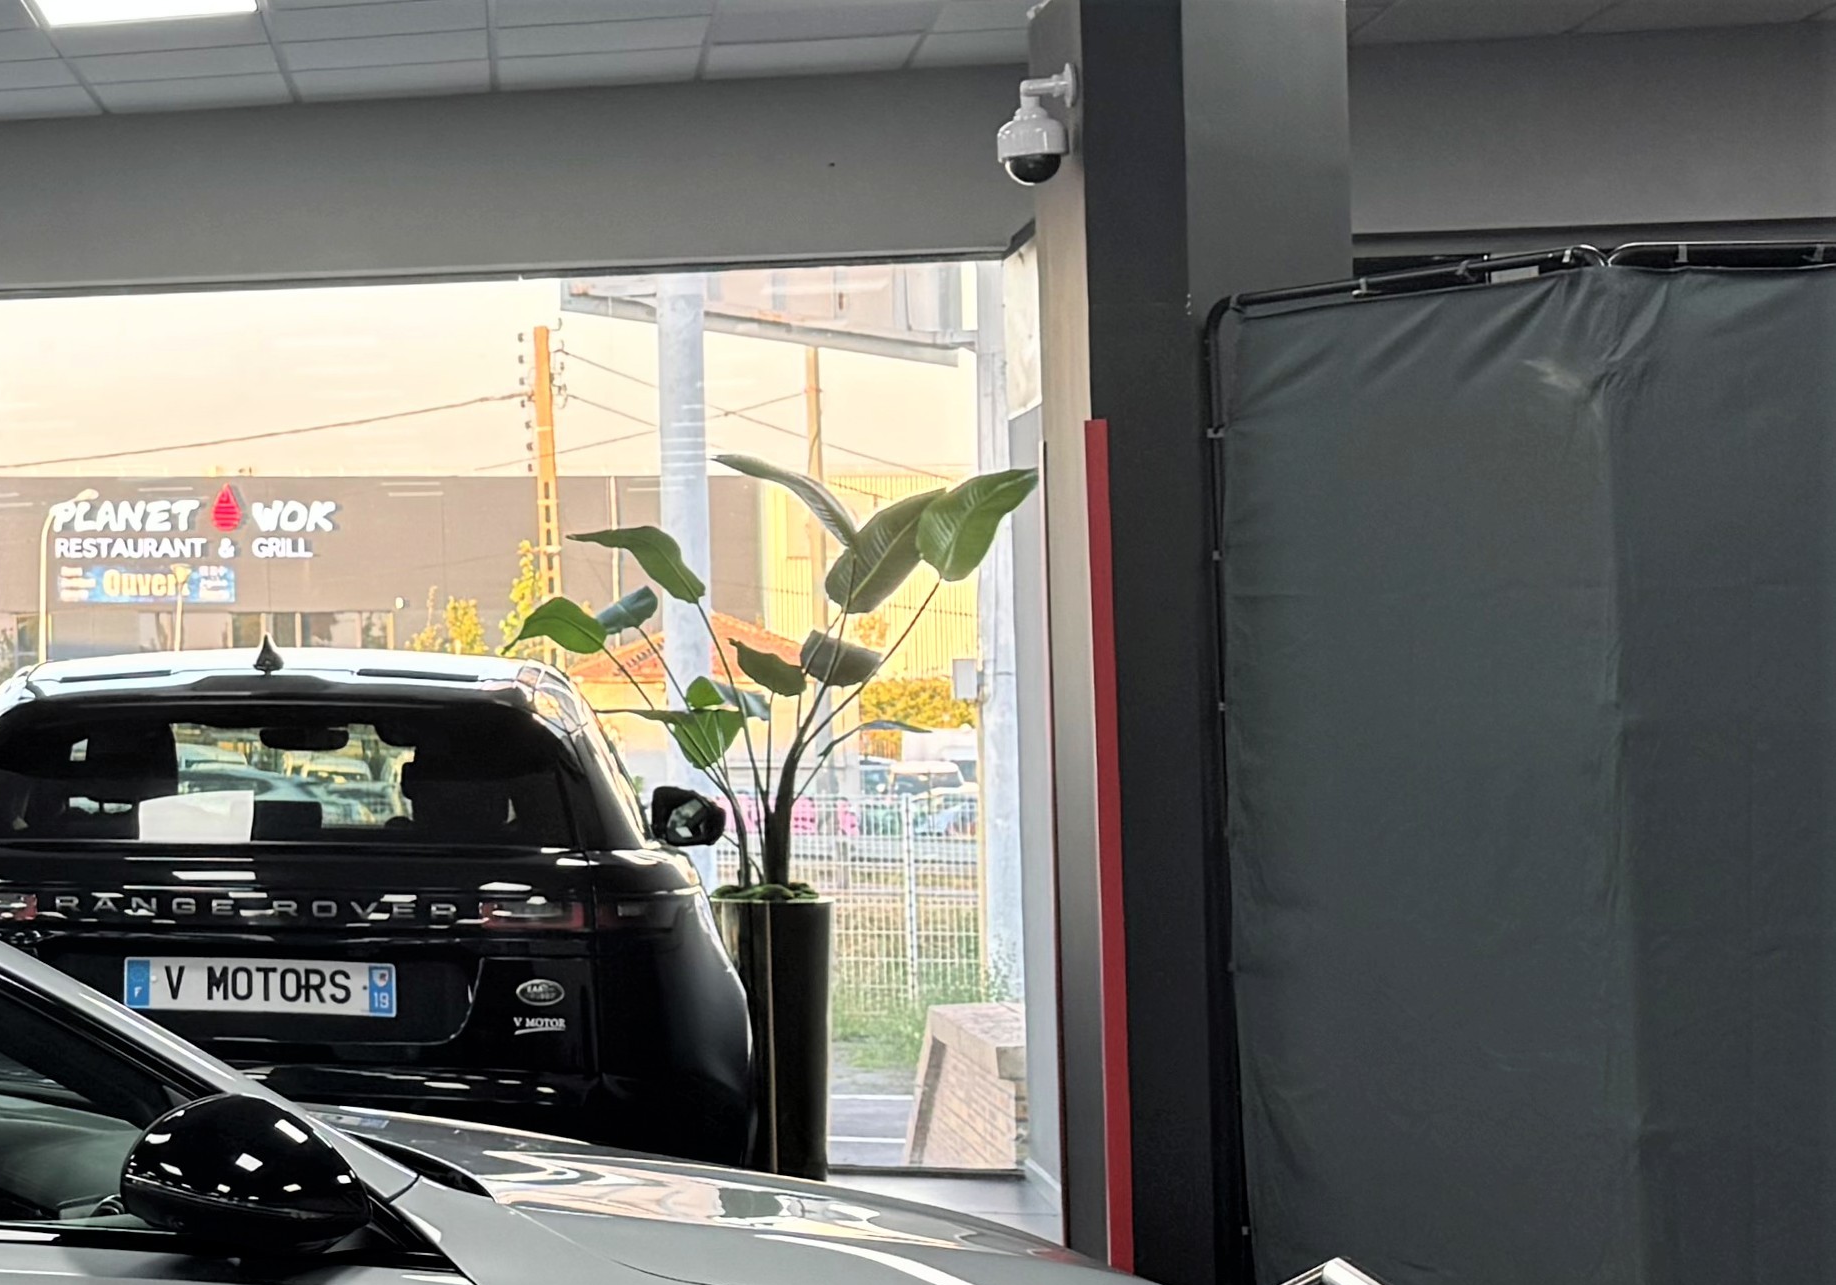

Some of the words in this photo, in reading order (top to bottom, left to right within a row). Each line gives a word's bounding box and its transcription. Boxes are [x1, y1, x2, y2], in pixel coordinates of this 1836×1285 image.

[51, 499, 200, 532] PLANET
[251, 499, 336, 532] WOK
[54, 537, 207, 559] RESTAURANT
[218, 538, 235, 558] &
[252, 537, 314, 559] GRILL
[55, 895, 234, 916] RANGE
[272, 897, 458, 919] ROVER
[164, 965, 186, 1000] V
[206, 965, 352, 1005] MOTORS
[513, 1016, 523, 1028] V
